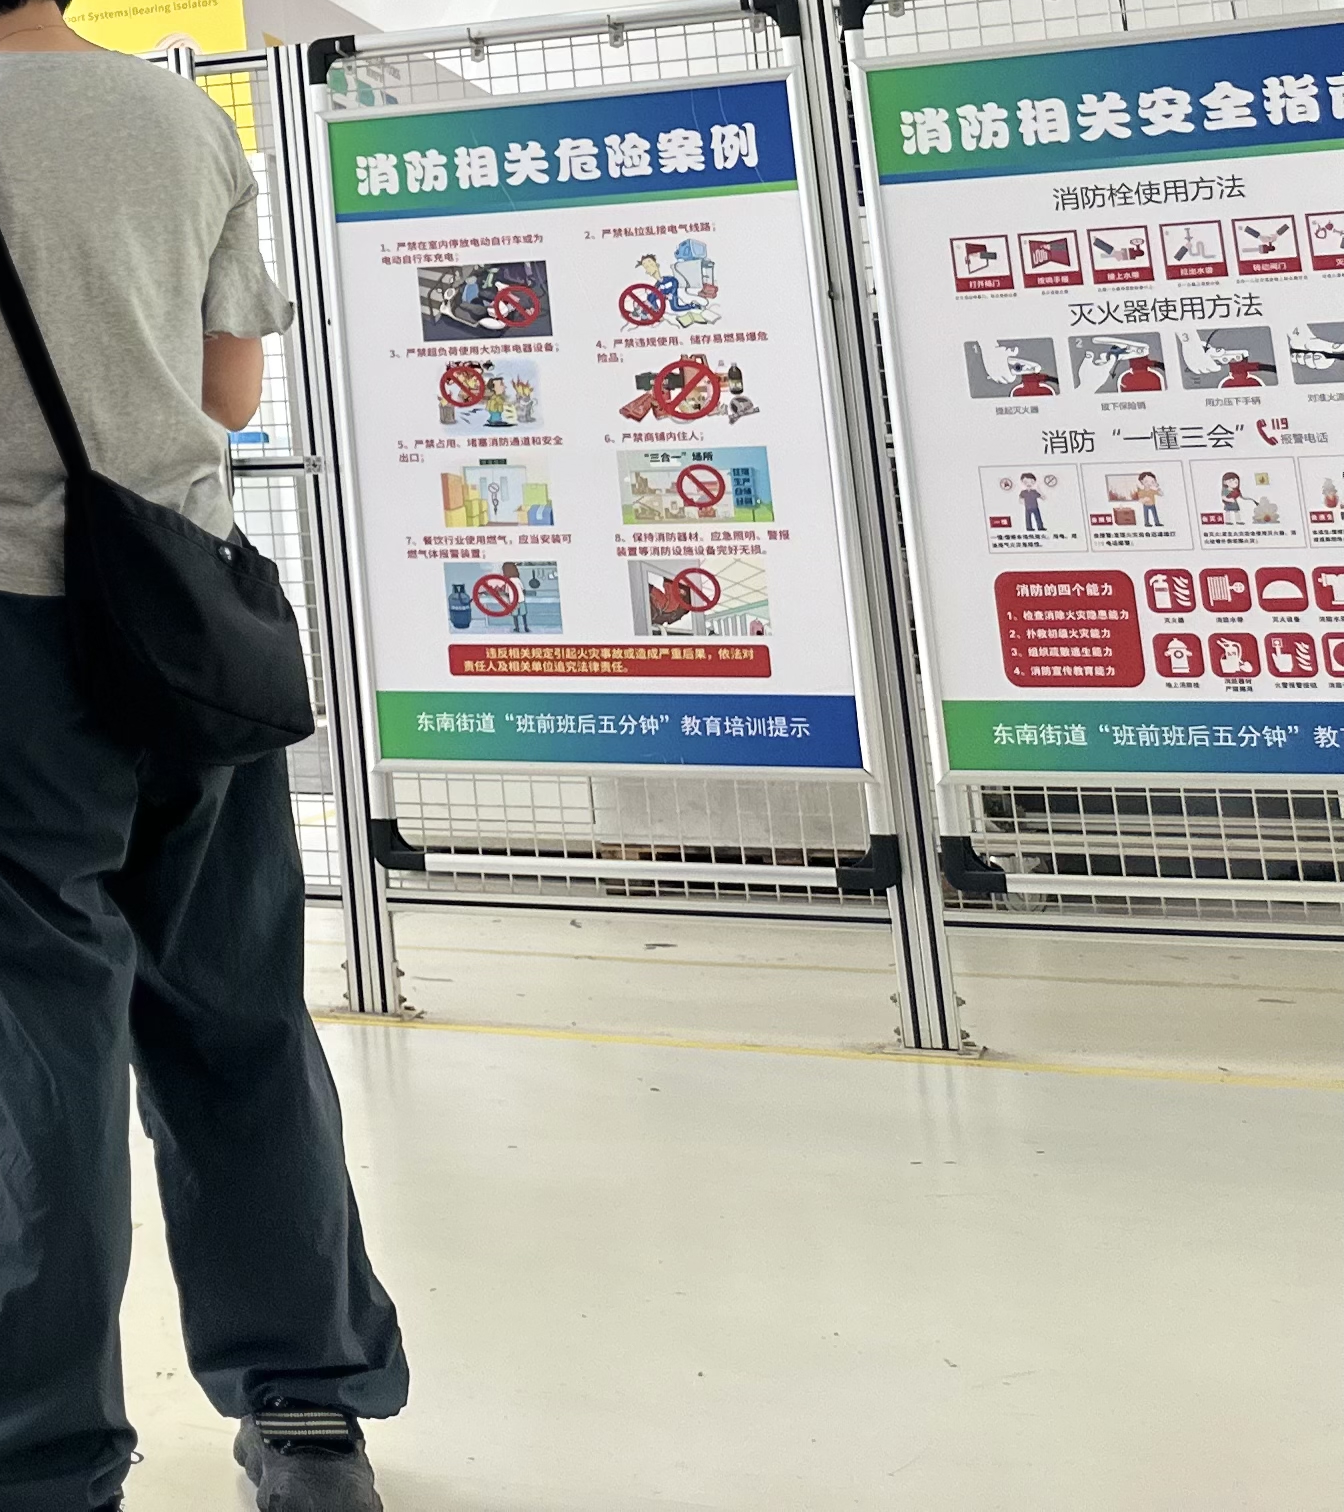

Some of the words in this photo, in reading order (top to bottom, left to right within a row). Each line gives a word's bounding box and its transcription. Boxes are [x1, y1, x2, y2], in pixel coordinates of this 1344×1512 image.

[355, 121, 760, 196] 消防相关危险案例
[1052, 175, 1246, 212] 消防栓使用方法
[1068, 292, 1263, 327] 灭火器使用方法
[1181, 333, 1190, 343] 3
[1292, 327, 1300, 337] 4
[1271, 417, 1289, 430] 119
[1042, 428, 1095, 455] 消防
[1280, 432, 1329, 445] 报警电话
[1016, 583, 1113, 597] 消防的四个能力
